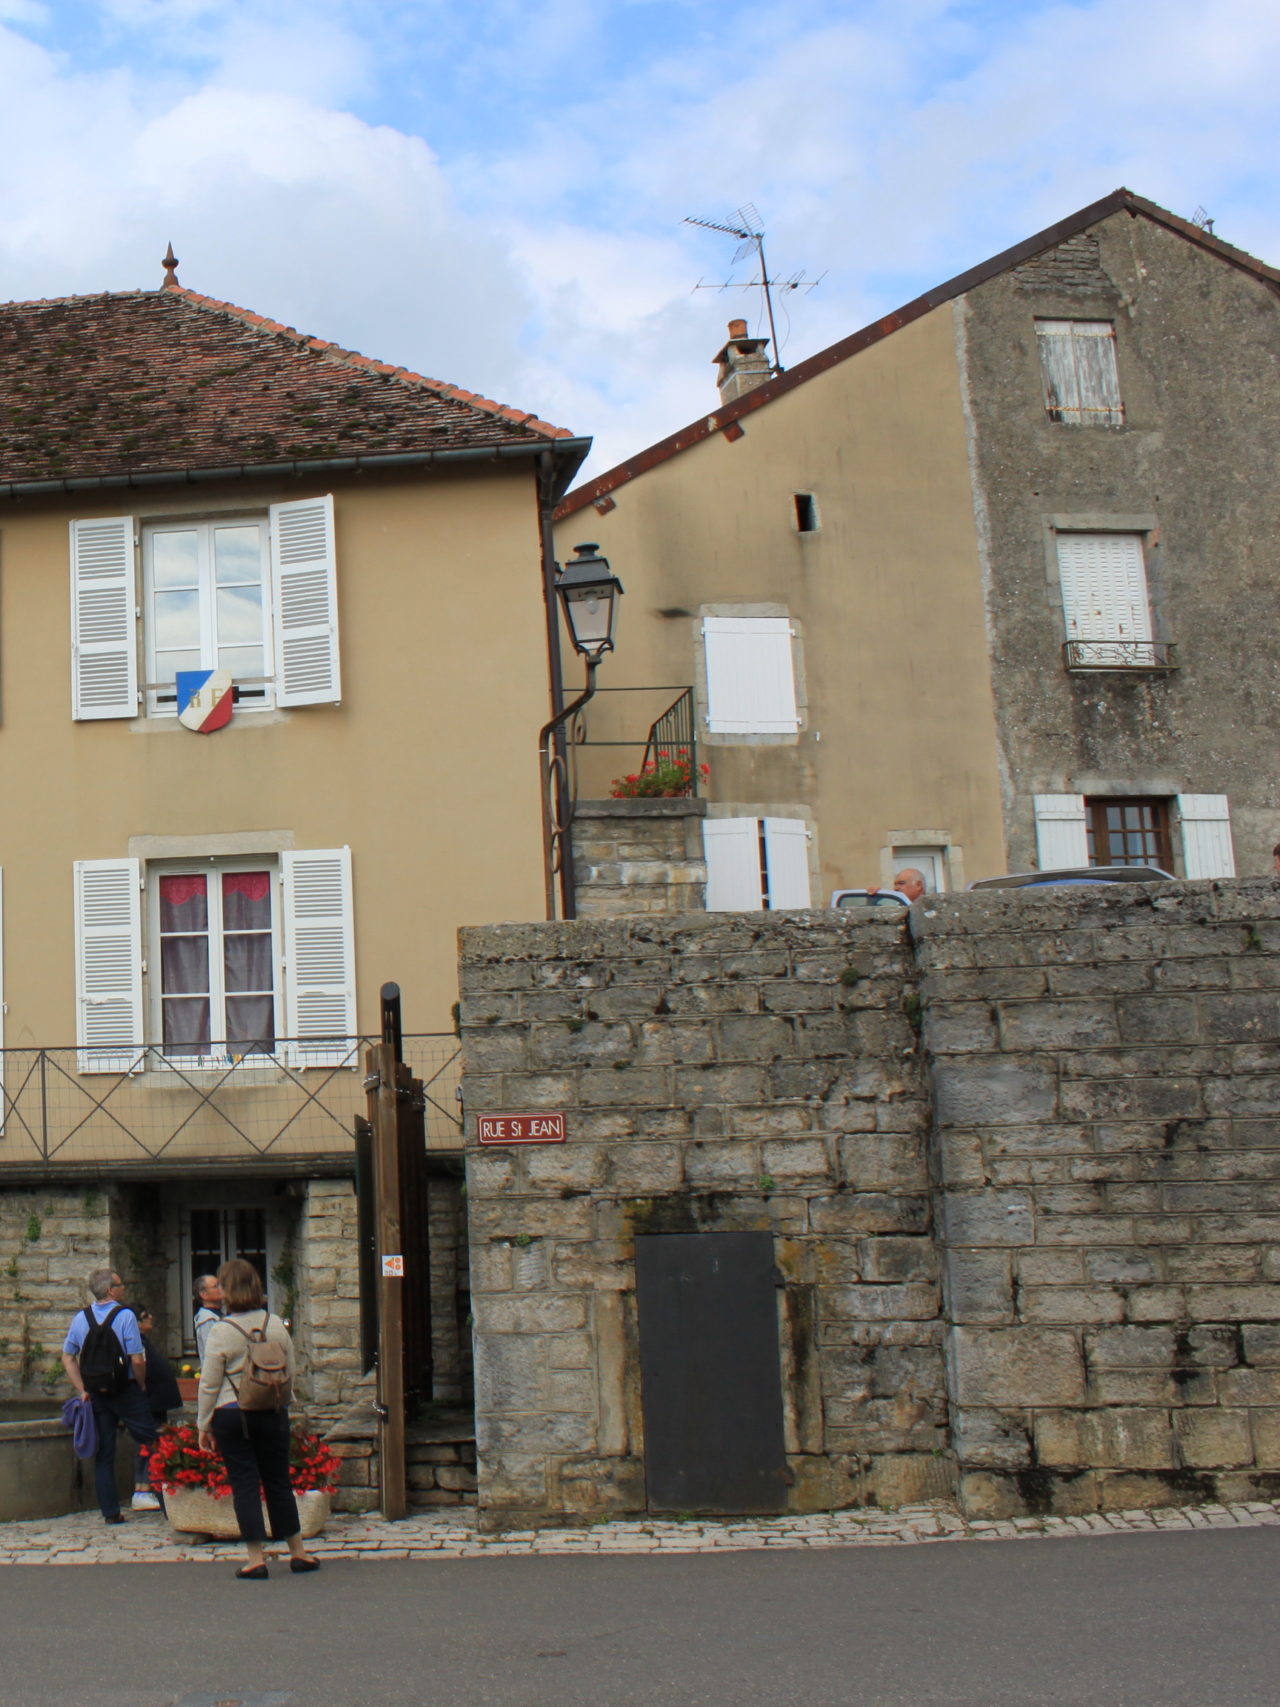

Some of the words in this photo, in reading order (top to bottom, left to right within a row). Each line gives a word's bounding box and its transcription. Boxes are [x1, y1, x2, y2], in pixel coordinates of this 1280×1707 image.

[483, 1121, 505, 1138] RUE
[511, 1121, 522, 1137] St
[528, 1119, 560, 1136] JEAN
